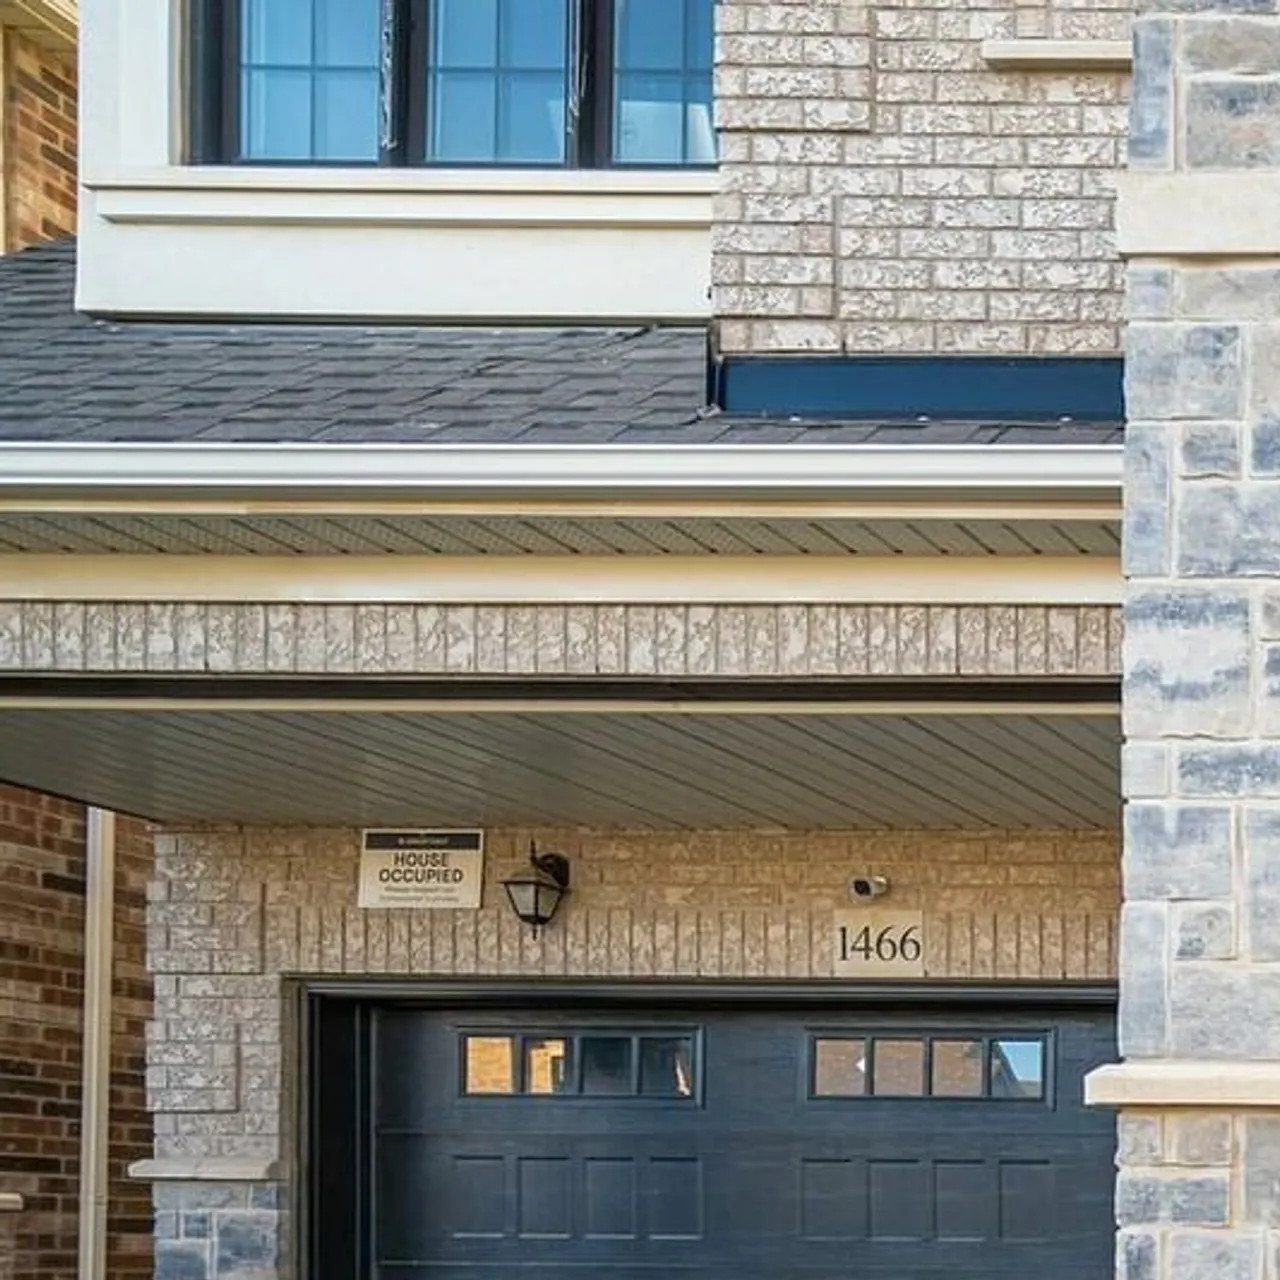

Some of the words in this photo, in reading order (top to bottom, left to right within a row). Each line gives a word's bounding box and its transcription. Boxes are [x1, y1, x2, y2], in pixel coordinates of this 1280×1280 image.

[393, 852, 450, 867] HOUSE
[379, 868, 464, 883] OCCUPIED
[839, 926, 921, 961] 1466
